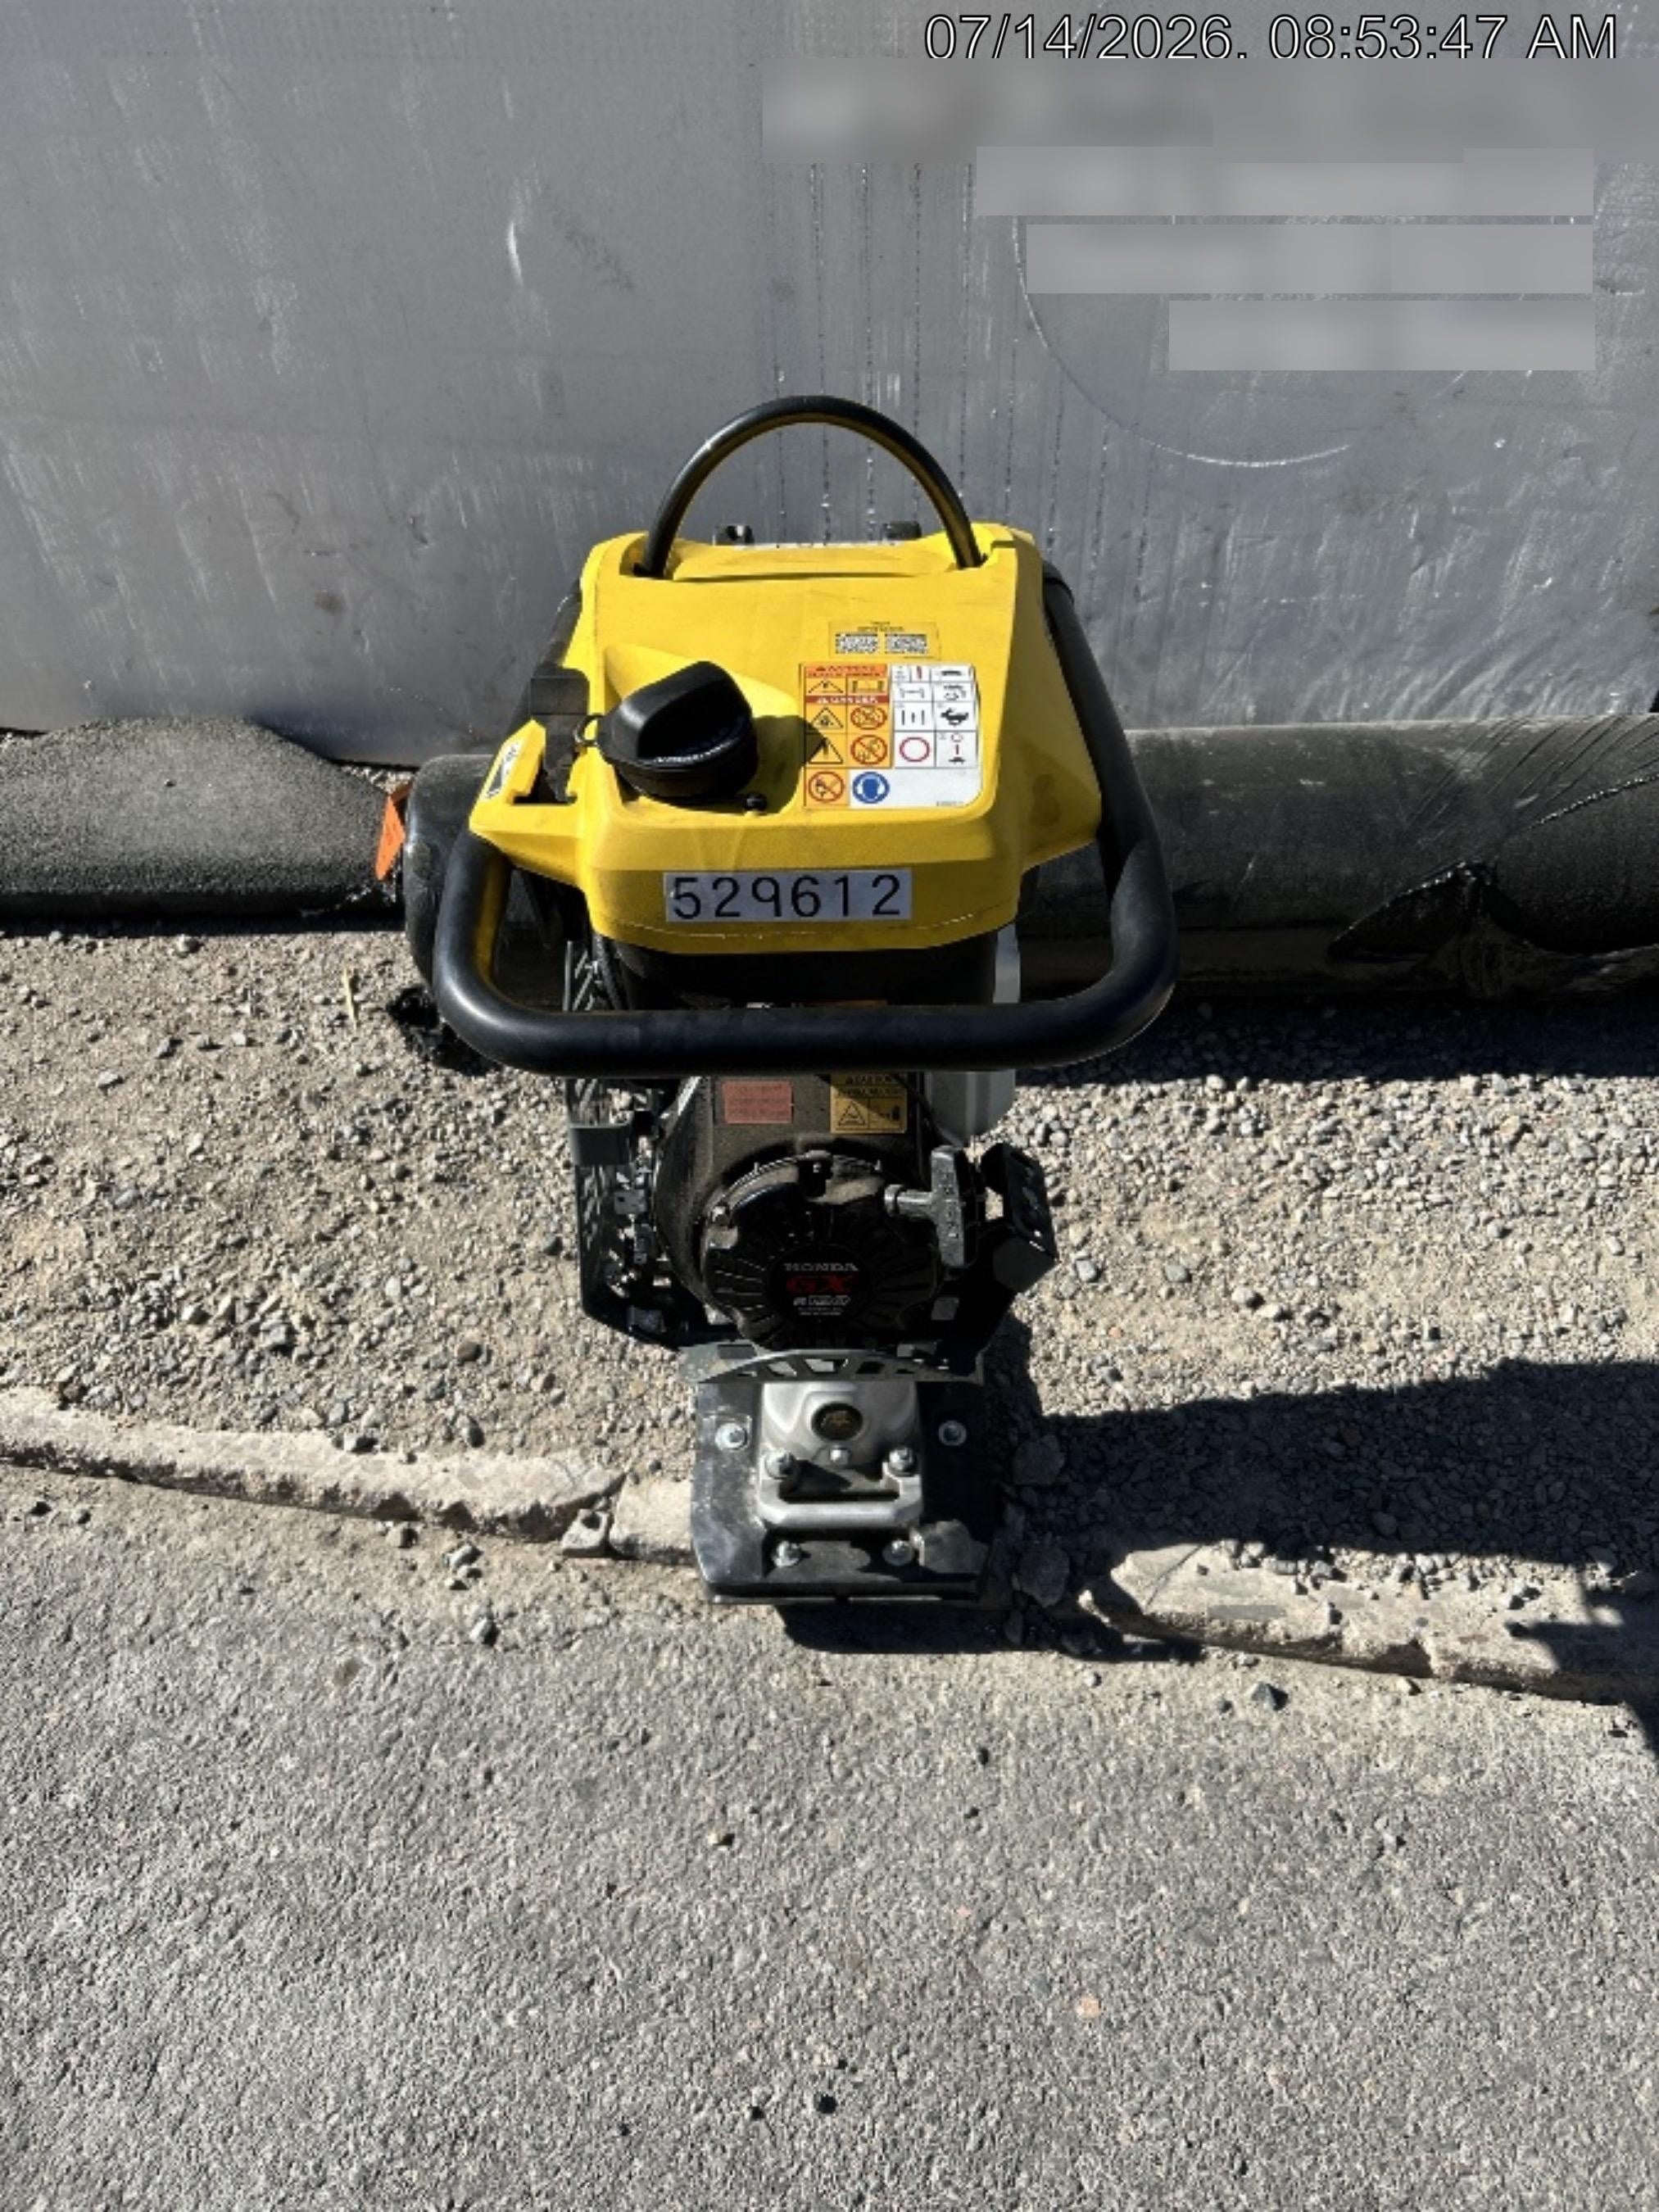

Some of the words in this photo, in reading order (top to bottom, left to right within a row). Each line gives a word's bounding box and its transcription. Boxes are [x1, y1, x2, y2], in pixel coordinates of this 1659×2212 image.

[673, 874, 900, 919] 529612
[783, 1262, 859, 1271] HONDA
[786, 1275, 854, 1294] GX
